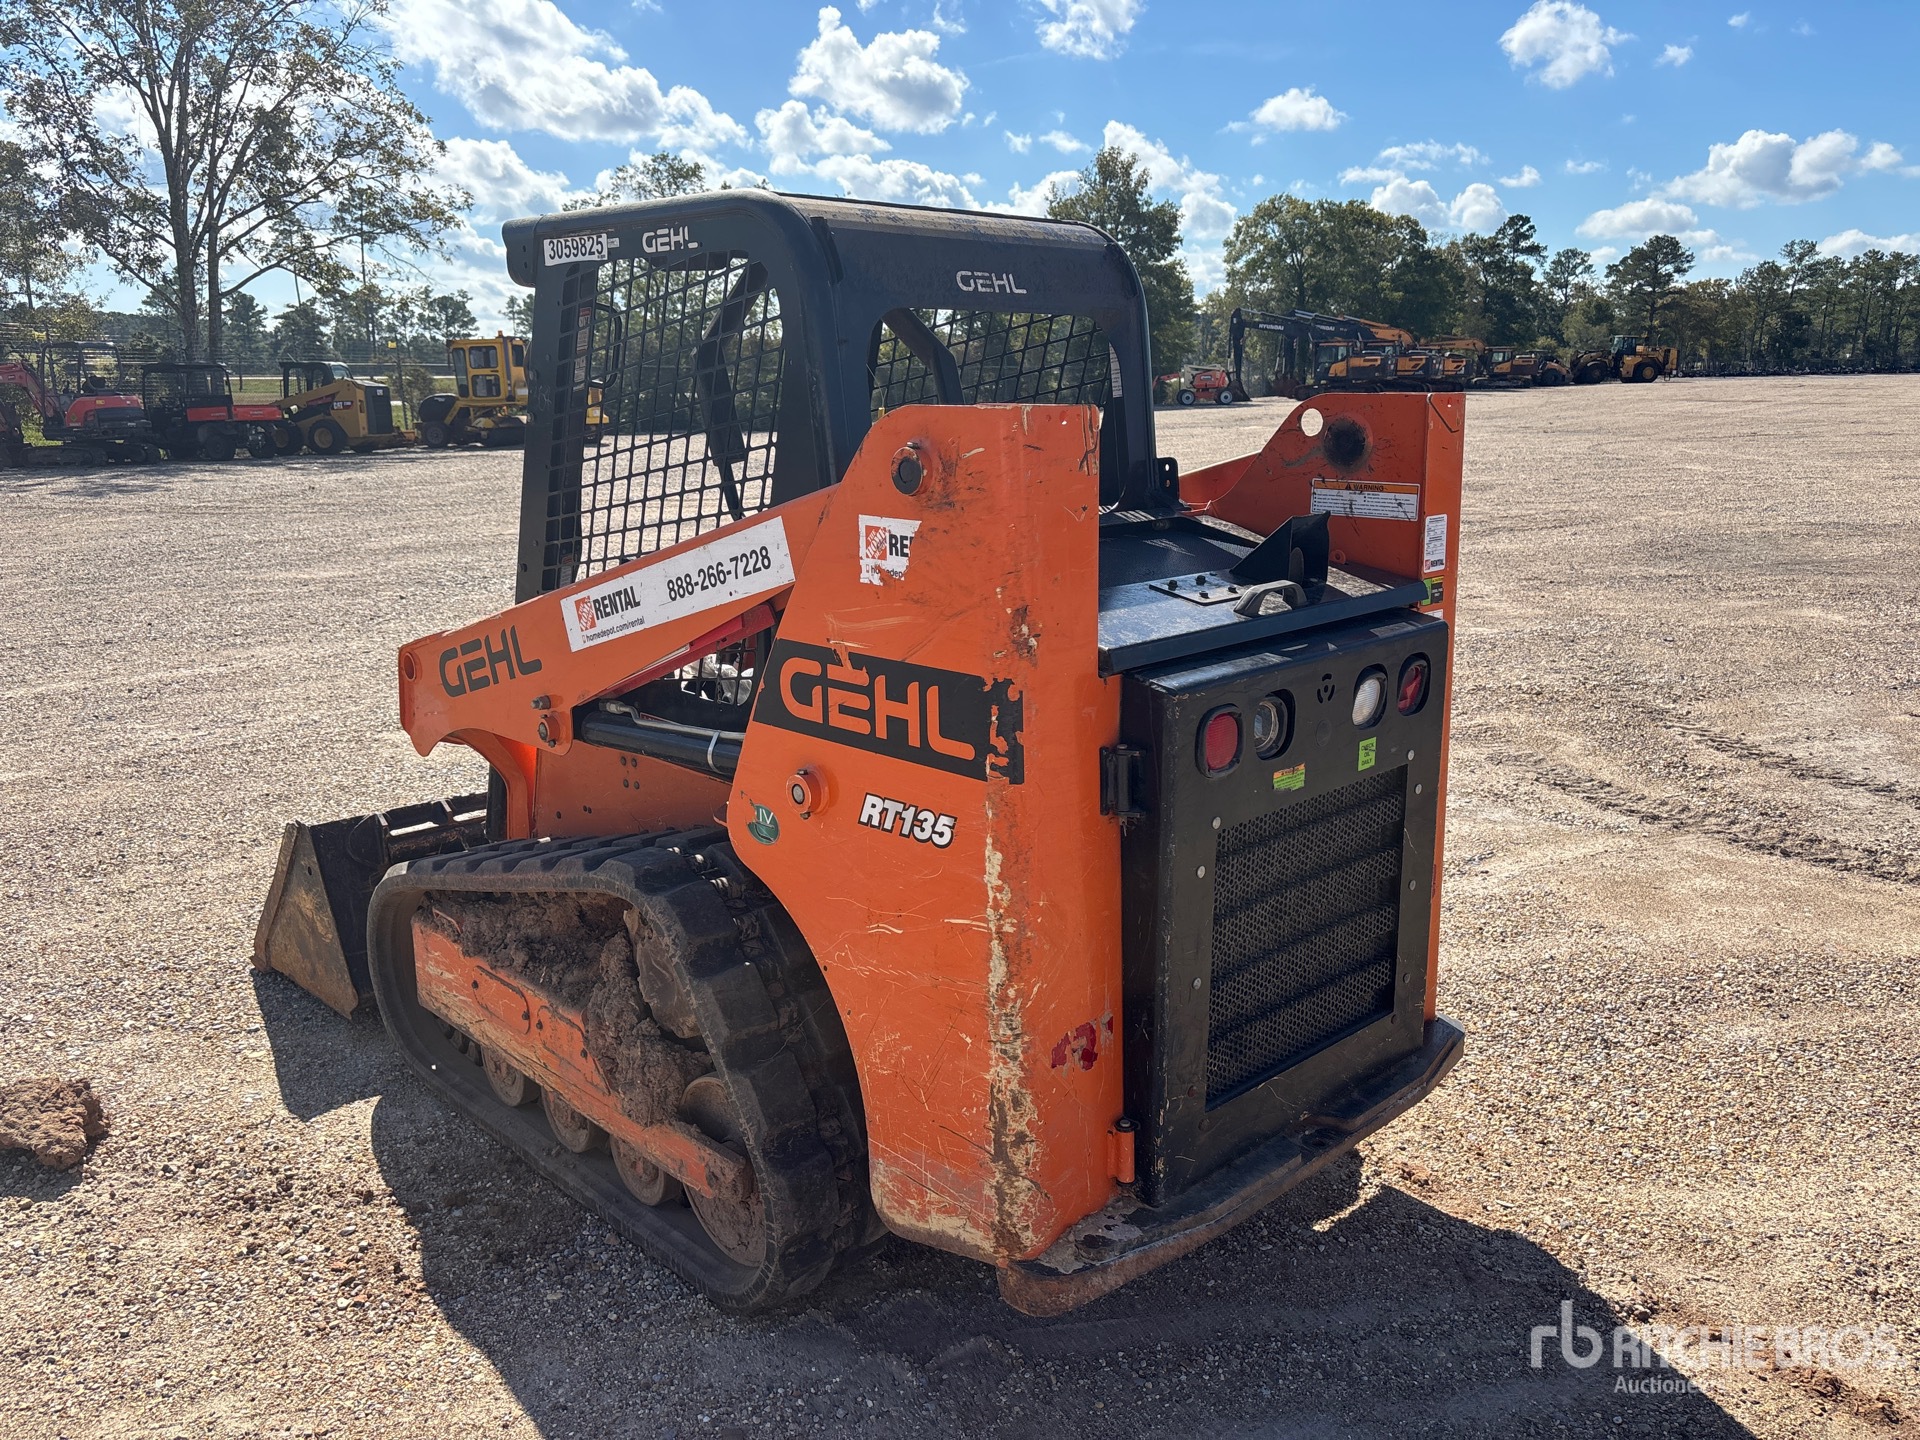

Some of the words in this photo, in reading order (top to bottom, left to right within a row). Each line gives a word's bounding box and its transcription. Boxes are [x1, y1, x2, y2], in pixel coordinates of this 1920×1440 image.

[549, 235, 604, 260] 3059825
[642, 225, 698, 253] GEHL
[956, 270, 1027, 294] GEHL
[1258, 323, 1285, 331] HYUNDAI
[1353, 484, 1384, 492] WARNING
[888, 533, 914, 557] RE
[666, 545, 772, 602] 888-266-7228
[593, 586, 641, 620] RENTAL
[586, 616, 645, 642] homedepot.com/rental
[439, 625, 542, 697] GEHL
[779, 657, 975, 761] GEHL
[1361, 758, 1372, 766] DAILY
[858, 792, 957, 848] RT135
